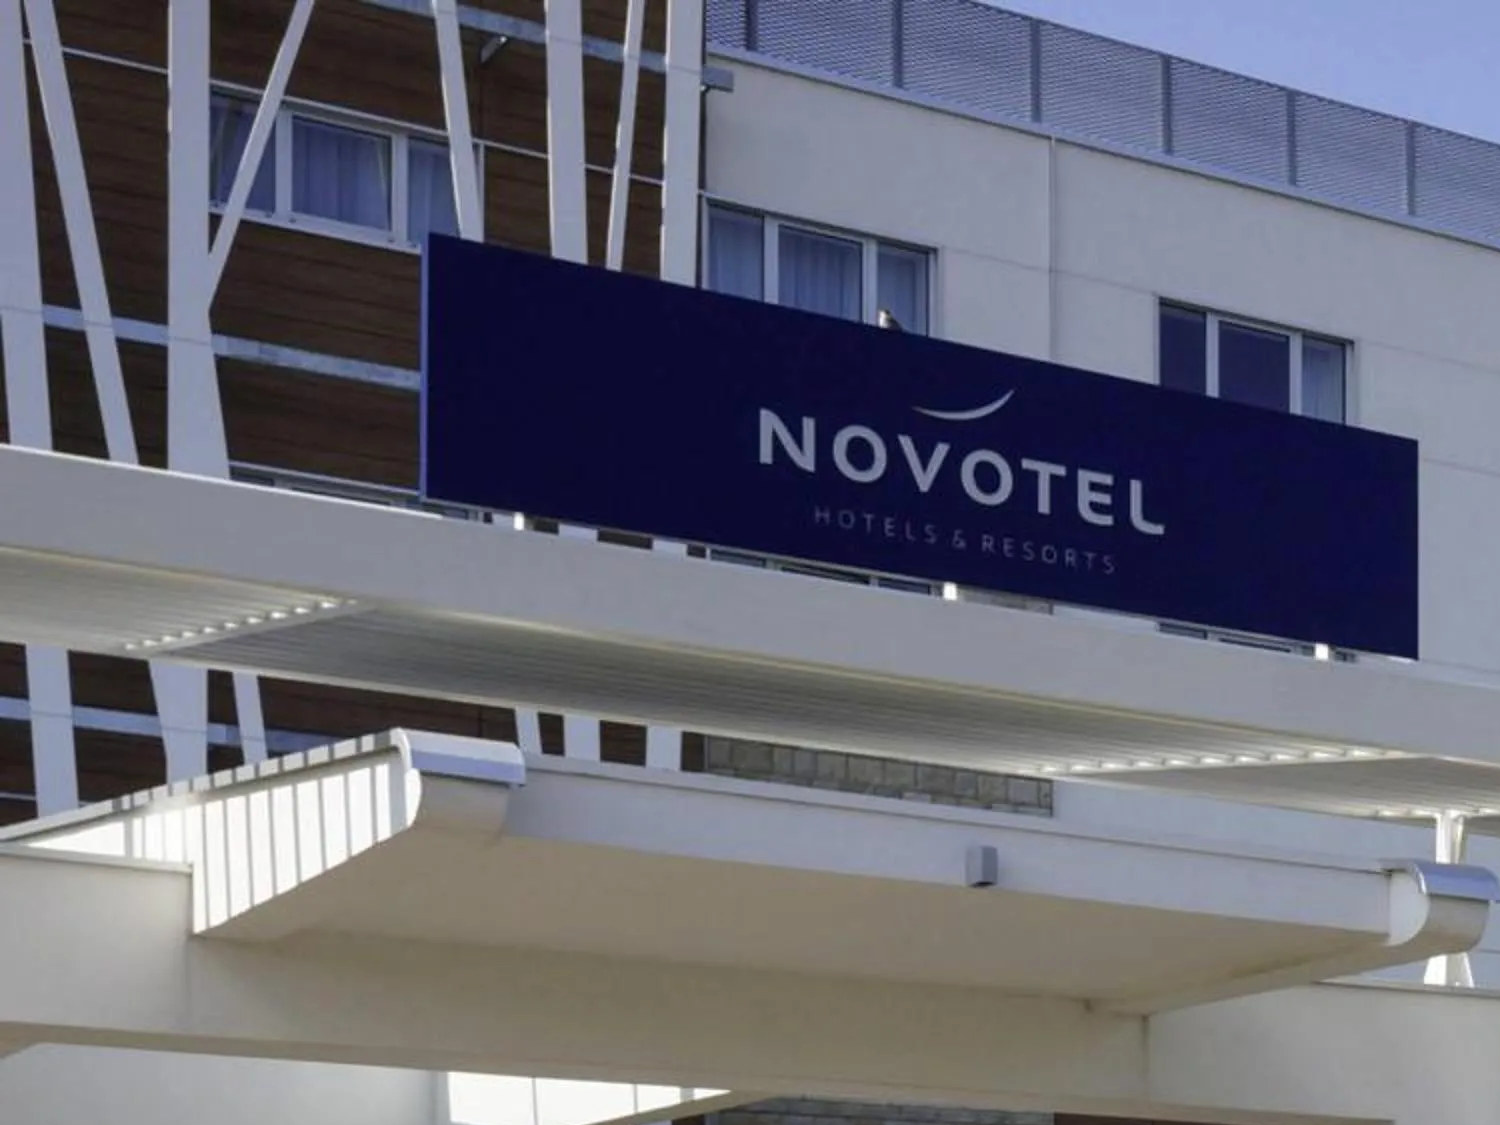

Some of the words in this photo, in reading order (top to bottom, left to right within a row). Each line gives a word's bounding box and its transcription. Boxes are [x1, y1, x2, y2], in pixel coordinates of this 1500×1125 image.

[758, 407, 1166, 535] NOVOTEL
[814, 505, 938, 544] HOTELS
[951, 530, 968, 549] &
[981, 534, 1117, 575] RESORTS
